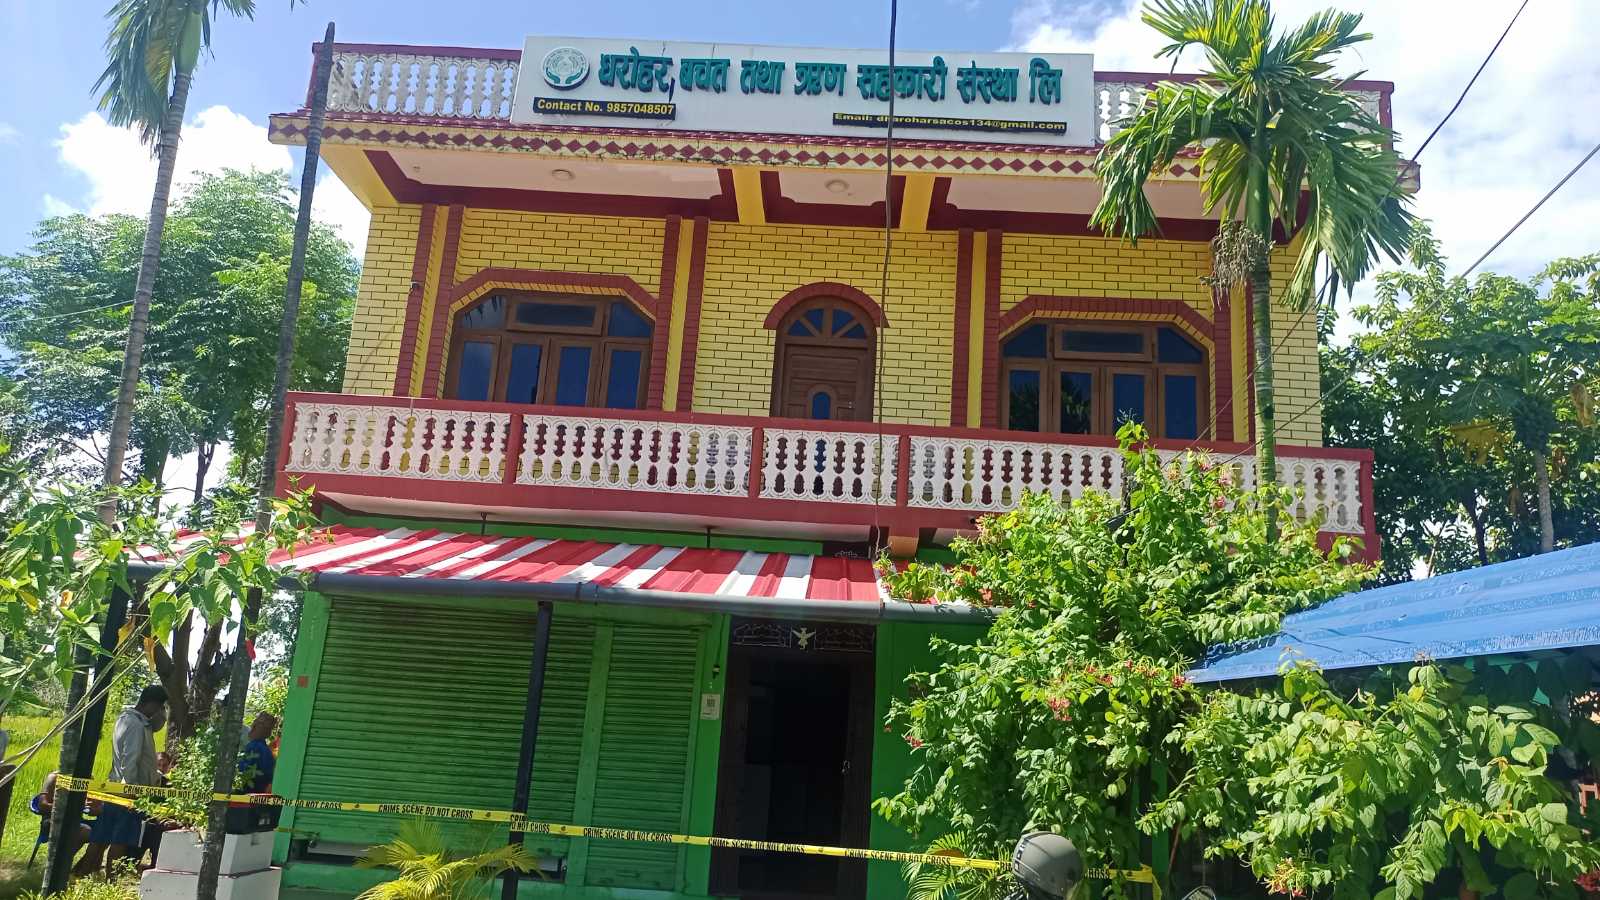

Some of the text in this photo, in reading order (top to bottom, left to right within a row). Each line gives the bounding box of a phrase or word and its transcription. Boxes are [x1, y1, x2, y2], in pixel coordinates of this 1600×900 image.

[680, 58, 730, 94] बचत
[740, 60, 785, 94] तथा
[794, 62, 847, 96] ऋण
[857, 56, 948, 102] सहकारी
[957, 60, 1019, 103] संस्था
[1029, 57, 1062, 105] लि
[537, 99, 674, 115] Contact No. 9857048507
[834, 112, 873, 122] Email:
[123, 784, 143, 795] CRIME
[145, 786, 165, 797] SCENE
[167, 788, 176, 798] DO
[178, 789, 191, 799] NOT
[306, 800, 319, 808] NOT
[321, 801, 342, 810] CROSS
[378, 804, 473, 818] CRIME SCENE DO NOT CROSS
[516, 821, 529, 831] NOT
[530, 822, 550, 833] CROSS
[583, 827, 672, 843] CRIME SCENE DO NOT CROSS
[845, 848, 951, 865] CRIME SCENE DO NOT CROSS
